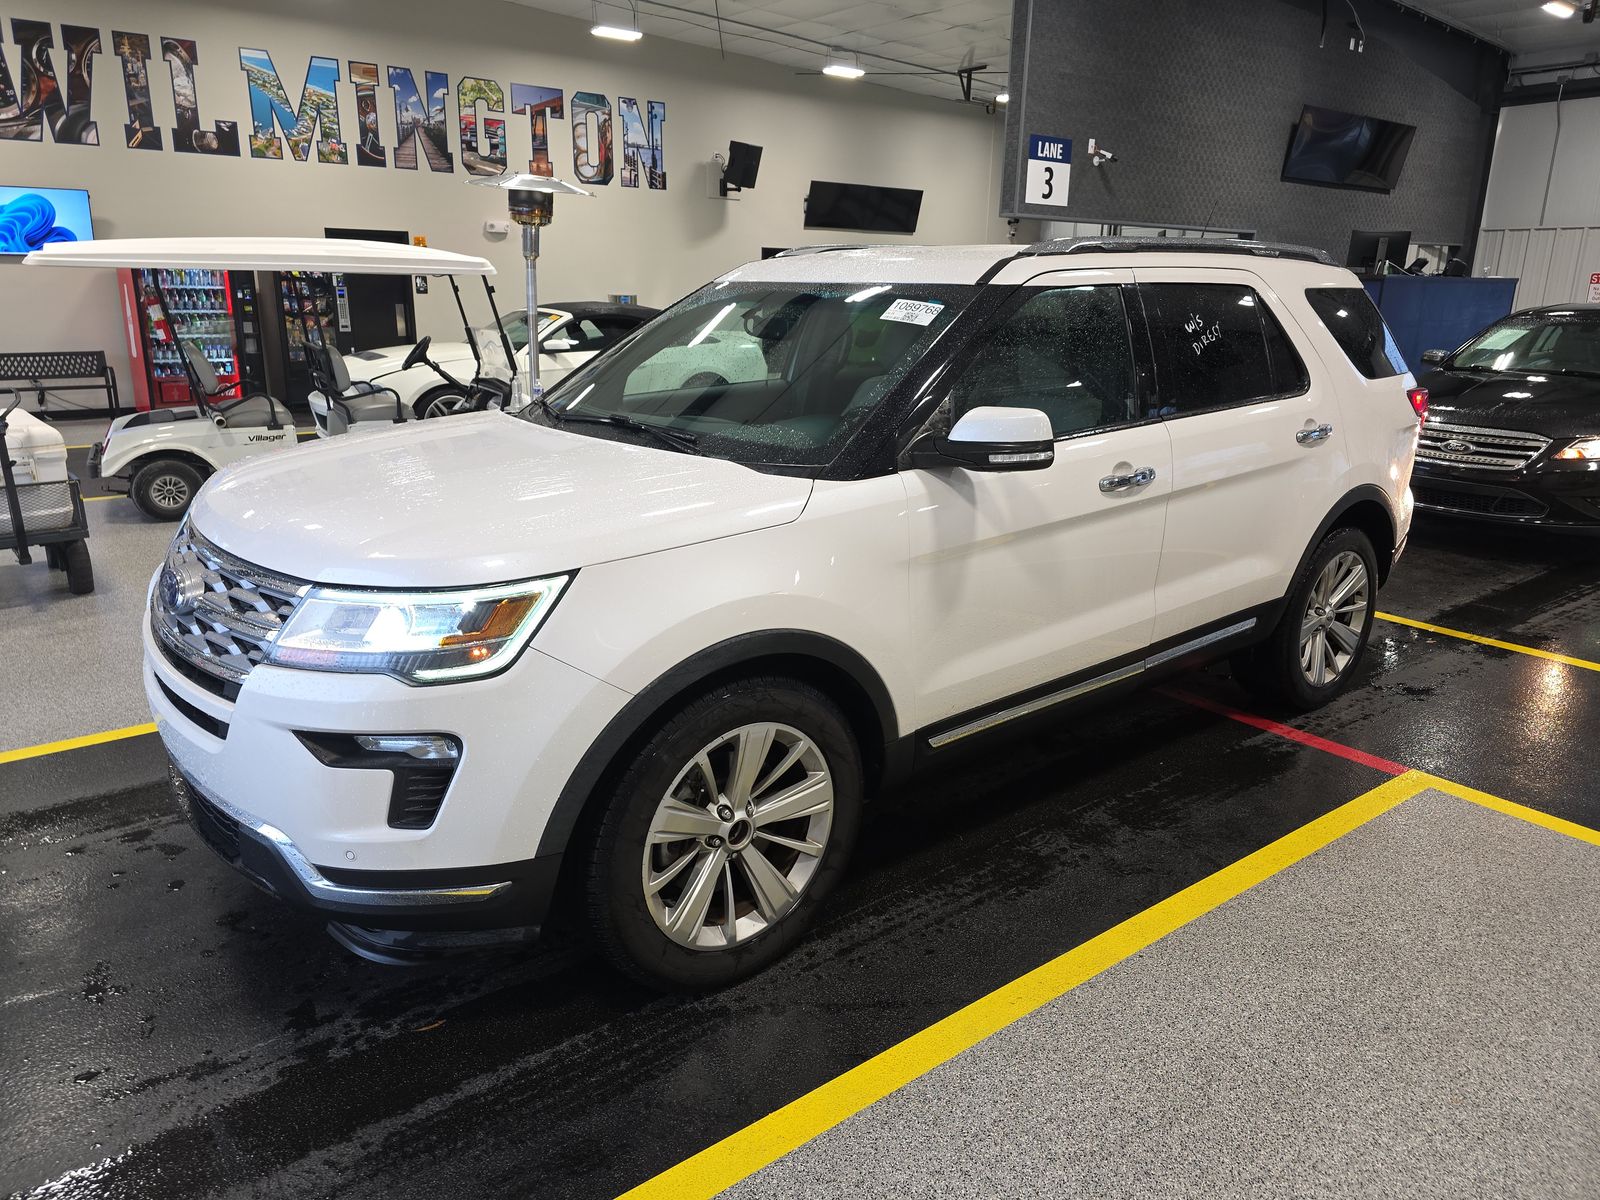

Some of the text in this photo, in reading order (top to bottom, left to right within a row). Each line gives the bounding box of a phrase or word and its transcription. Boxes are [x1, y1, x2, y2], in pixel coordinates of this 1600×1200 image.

[0, 18, 667, 190] WILMINGTON
[1037, 141, 1063, 159] LANE
[1042, 166, 1054, 200] 3
[894, 302, 942, 316] 1089768
[1192, 321, 1221, 355] DIRECT
[248, 434, 286, 443] Villager
[1447, 441, 1466, 451] Ford
